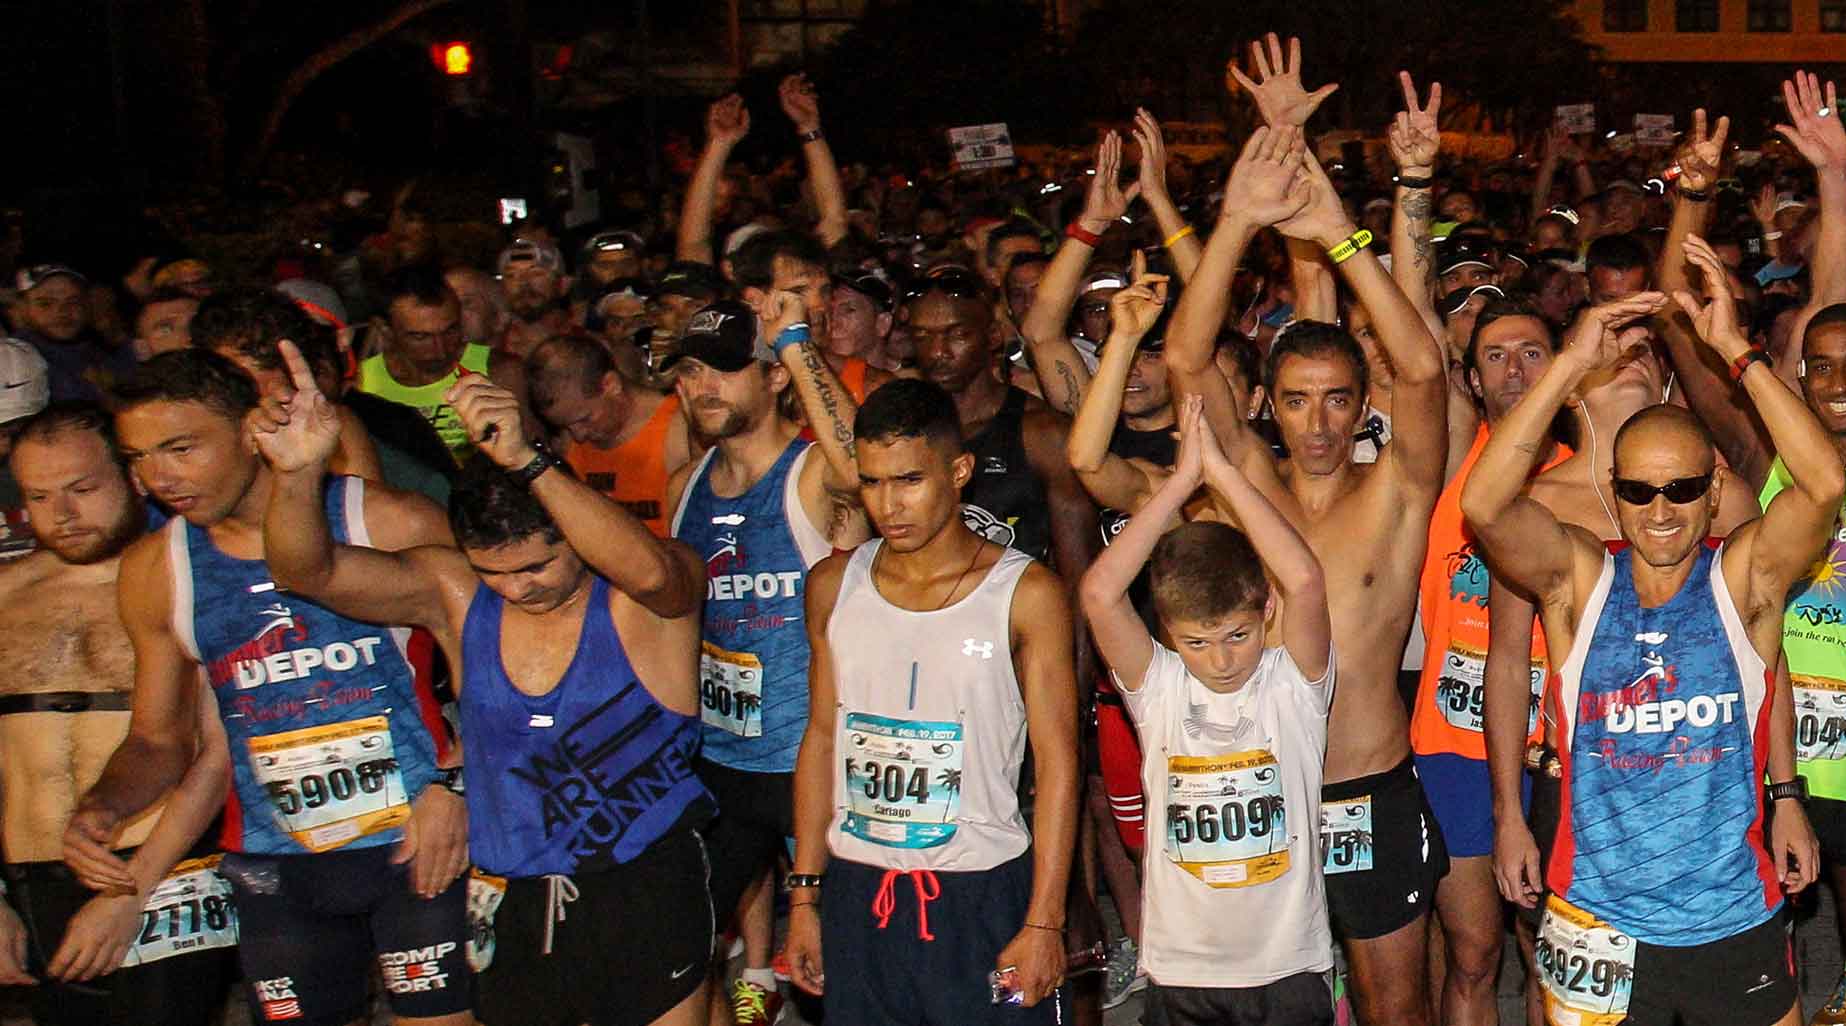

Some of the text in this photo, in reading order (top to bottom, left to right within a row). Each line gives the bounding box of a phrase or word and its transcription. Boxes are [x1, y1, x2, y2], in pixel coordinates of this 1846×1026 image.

[235, 636, 382, 690] DEPOT
[1607, 693, 1739, 734] DEPOT
[864, 761, 930, 804] 304
[1173, 797, 1273, 843] 5609
